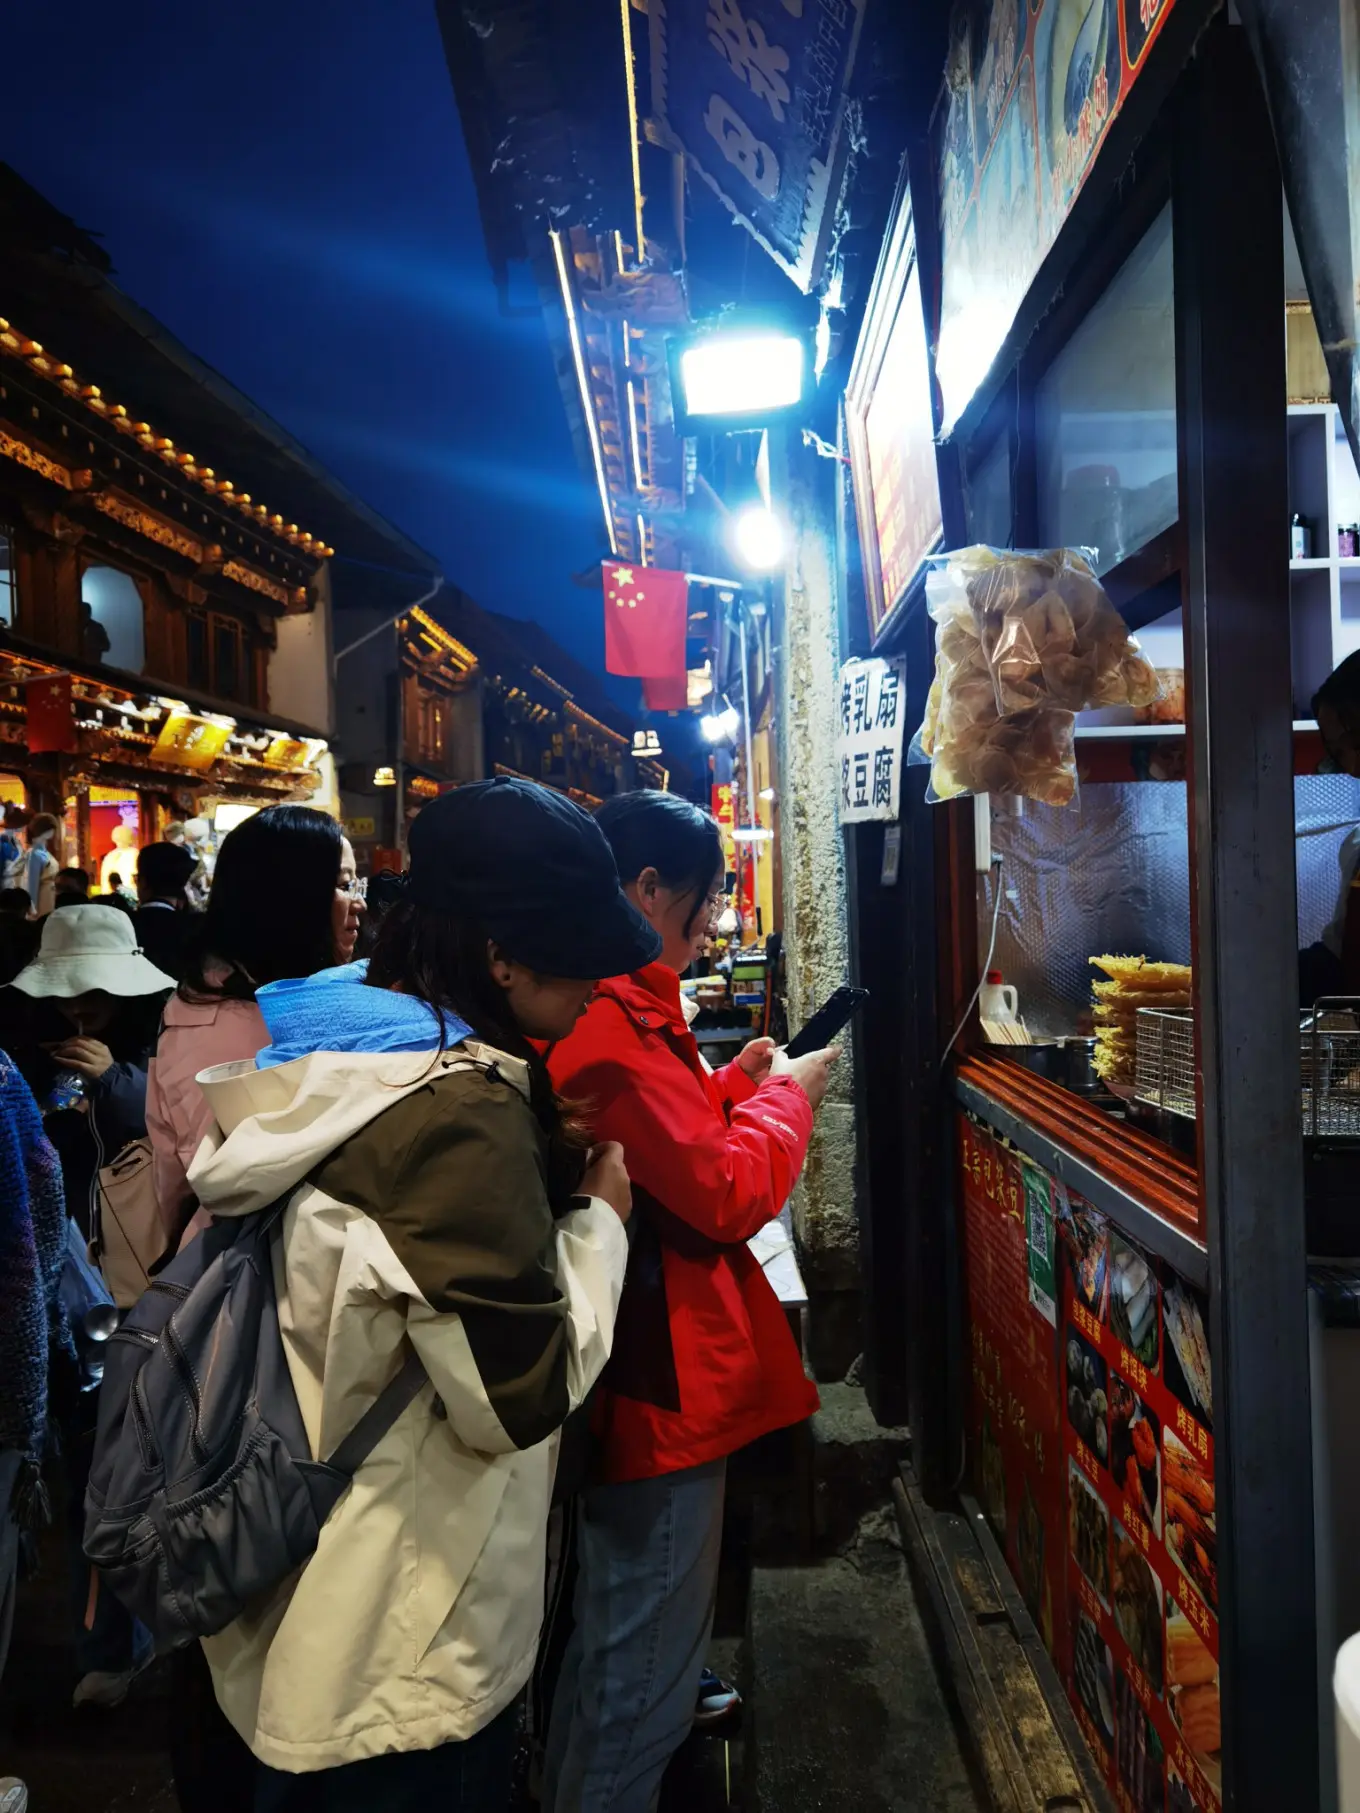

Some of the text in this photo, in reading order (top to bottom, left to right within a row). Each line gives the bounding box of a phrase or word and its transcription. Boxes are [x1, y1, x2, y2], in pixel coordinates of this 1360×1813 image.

[704, 0, 802, 200] 包浆
[1072, 1296, 1102, 1345] 包浆豆腐
[1176, 1403, 1209, 1460] 烤乳扇
[1076, 1440, 1100, 1483] 烤土豆
[1178, 1575, 1212, 1639] 烤玉米
